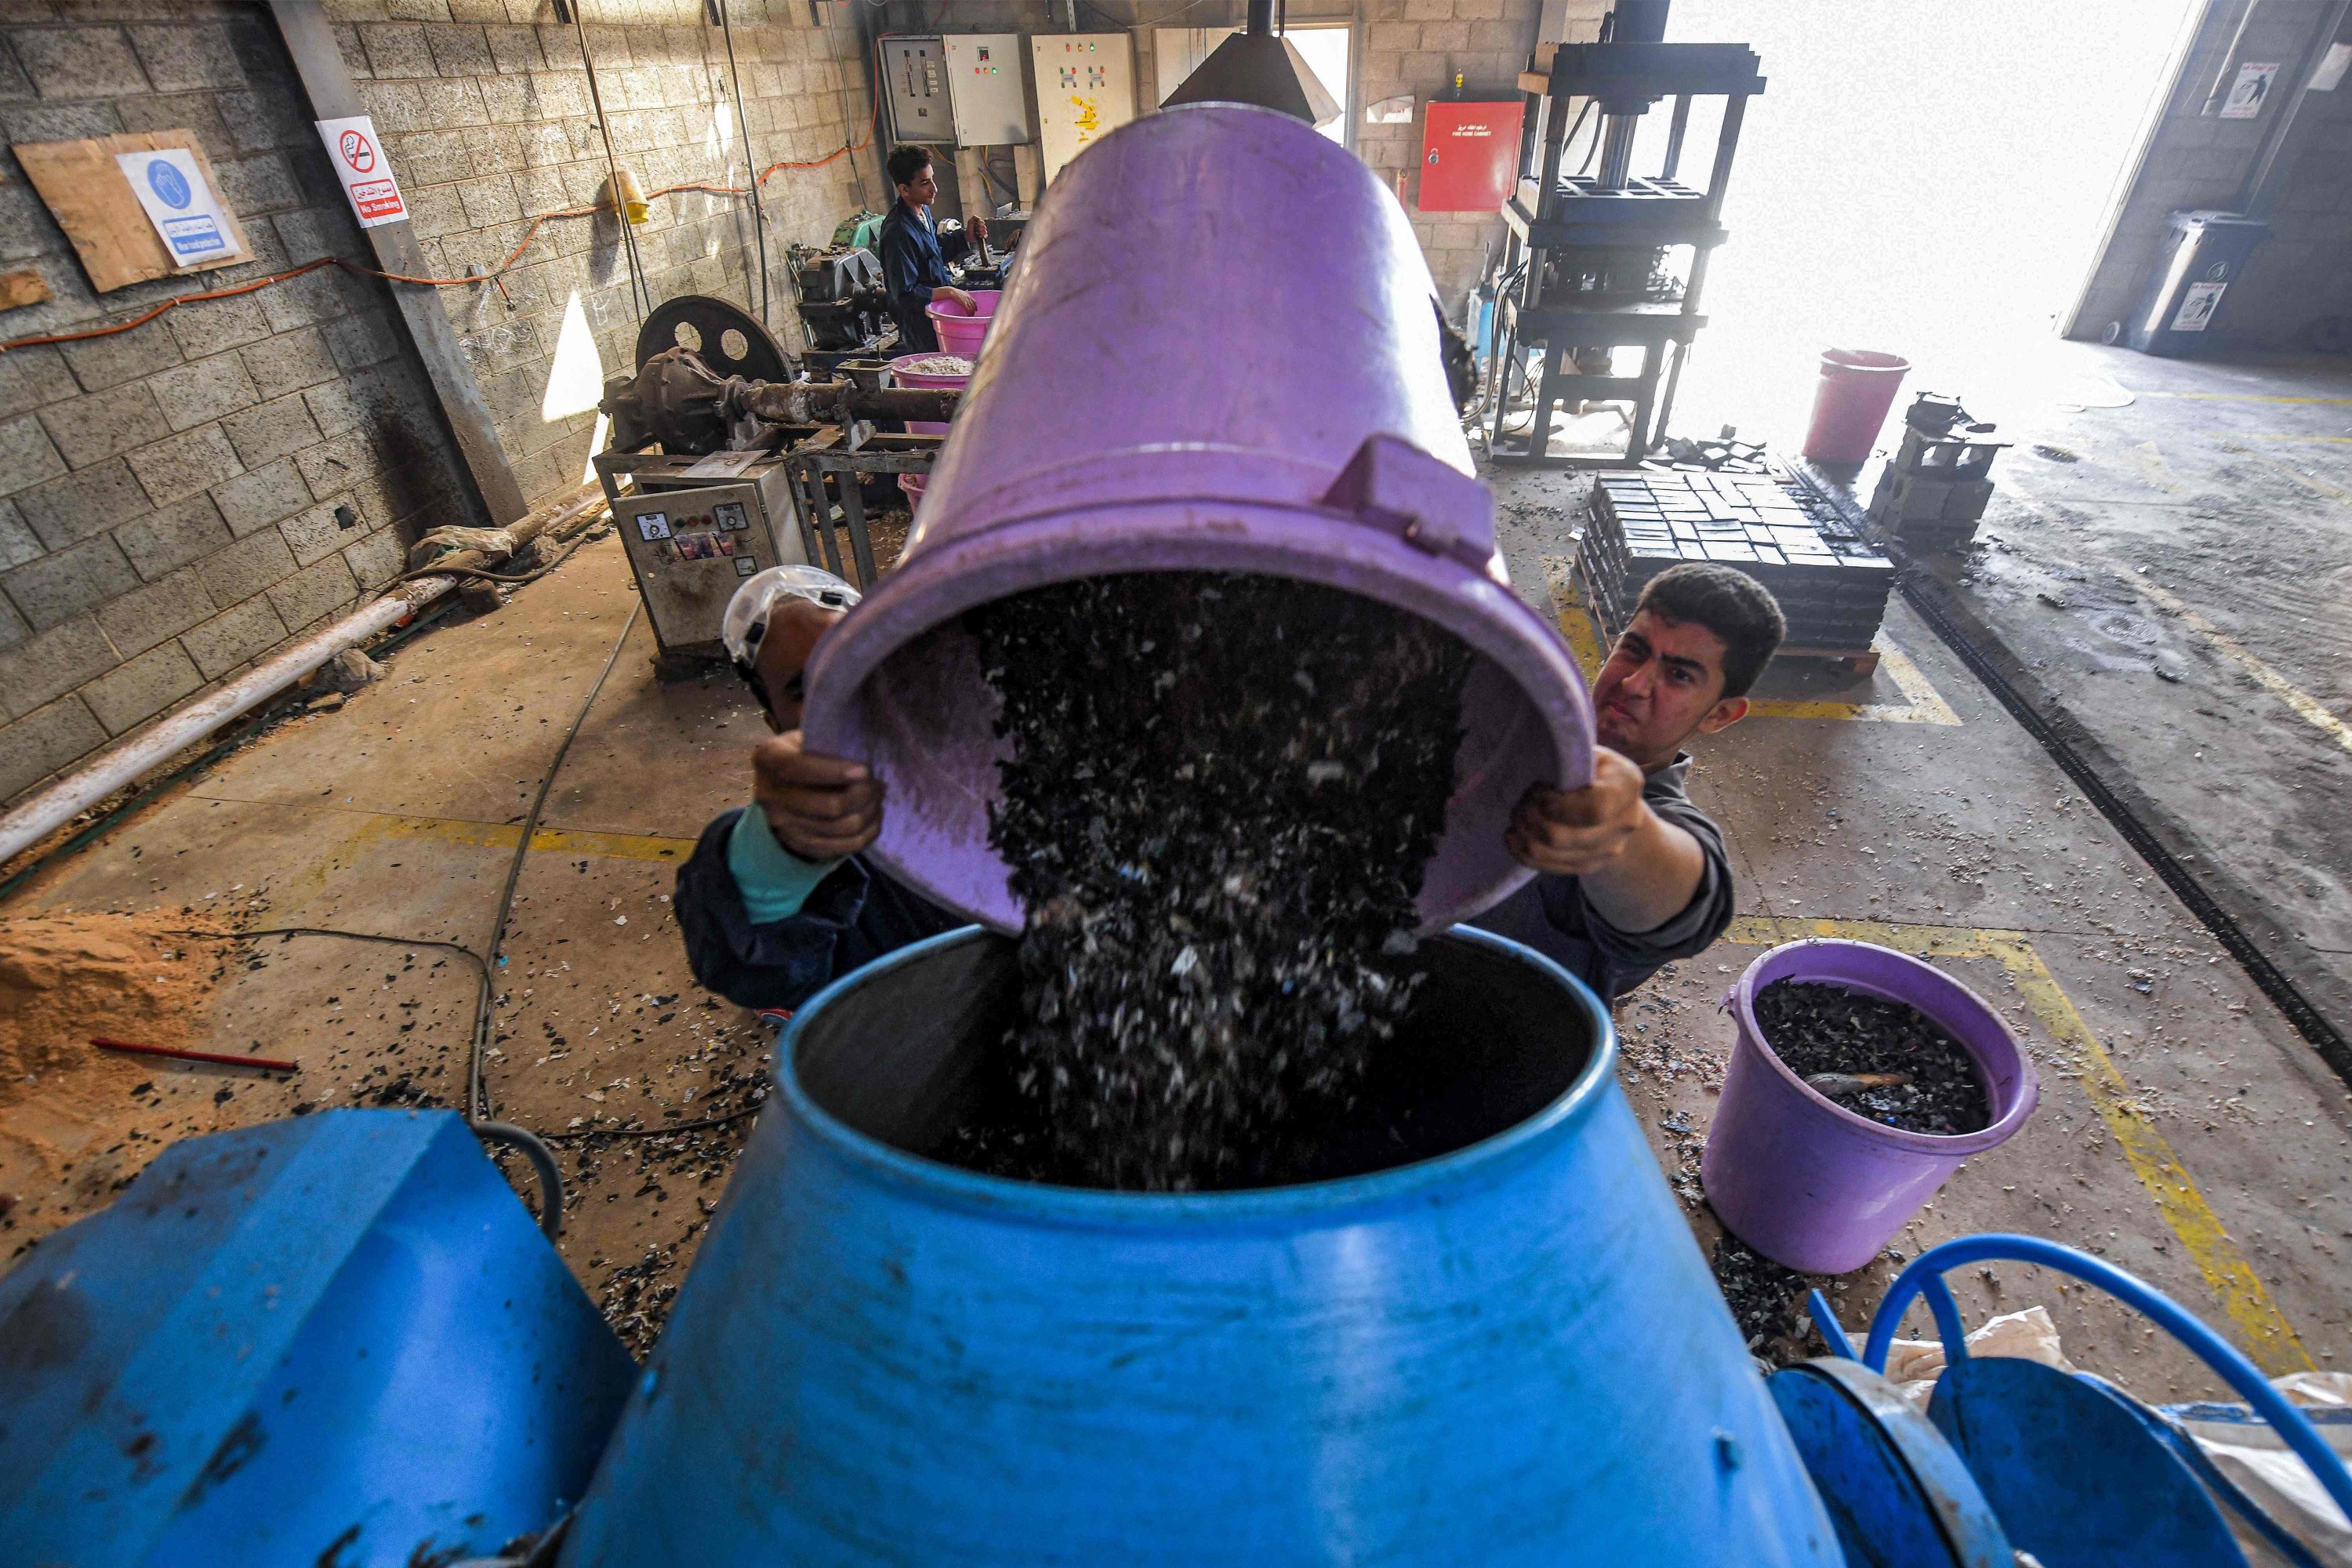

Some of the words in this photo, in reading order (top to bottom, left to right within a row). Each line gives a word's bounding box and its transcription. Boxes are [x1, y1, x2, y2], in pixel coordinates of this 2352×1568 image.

[355, 187, 376, 199] التدخين
[377, 185, 392, 196] ممنوع
[360, 204, 372, 214] No
[371, 200, 401, 212] Smoking
